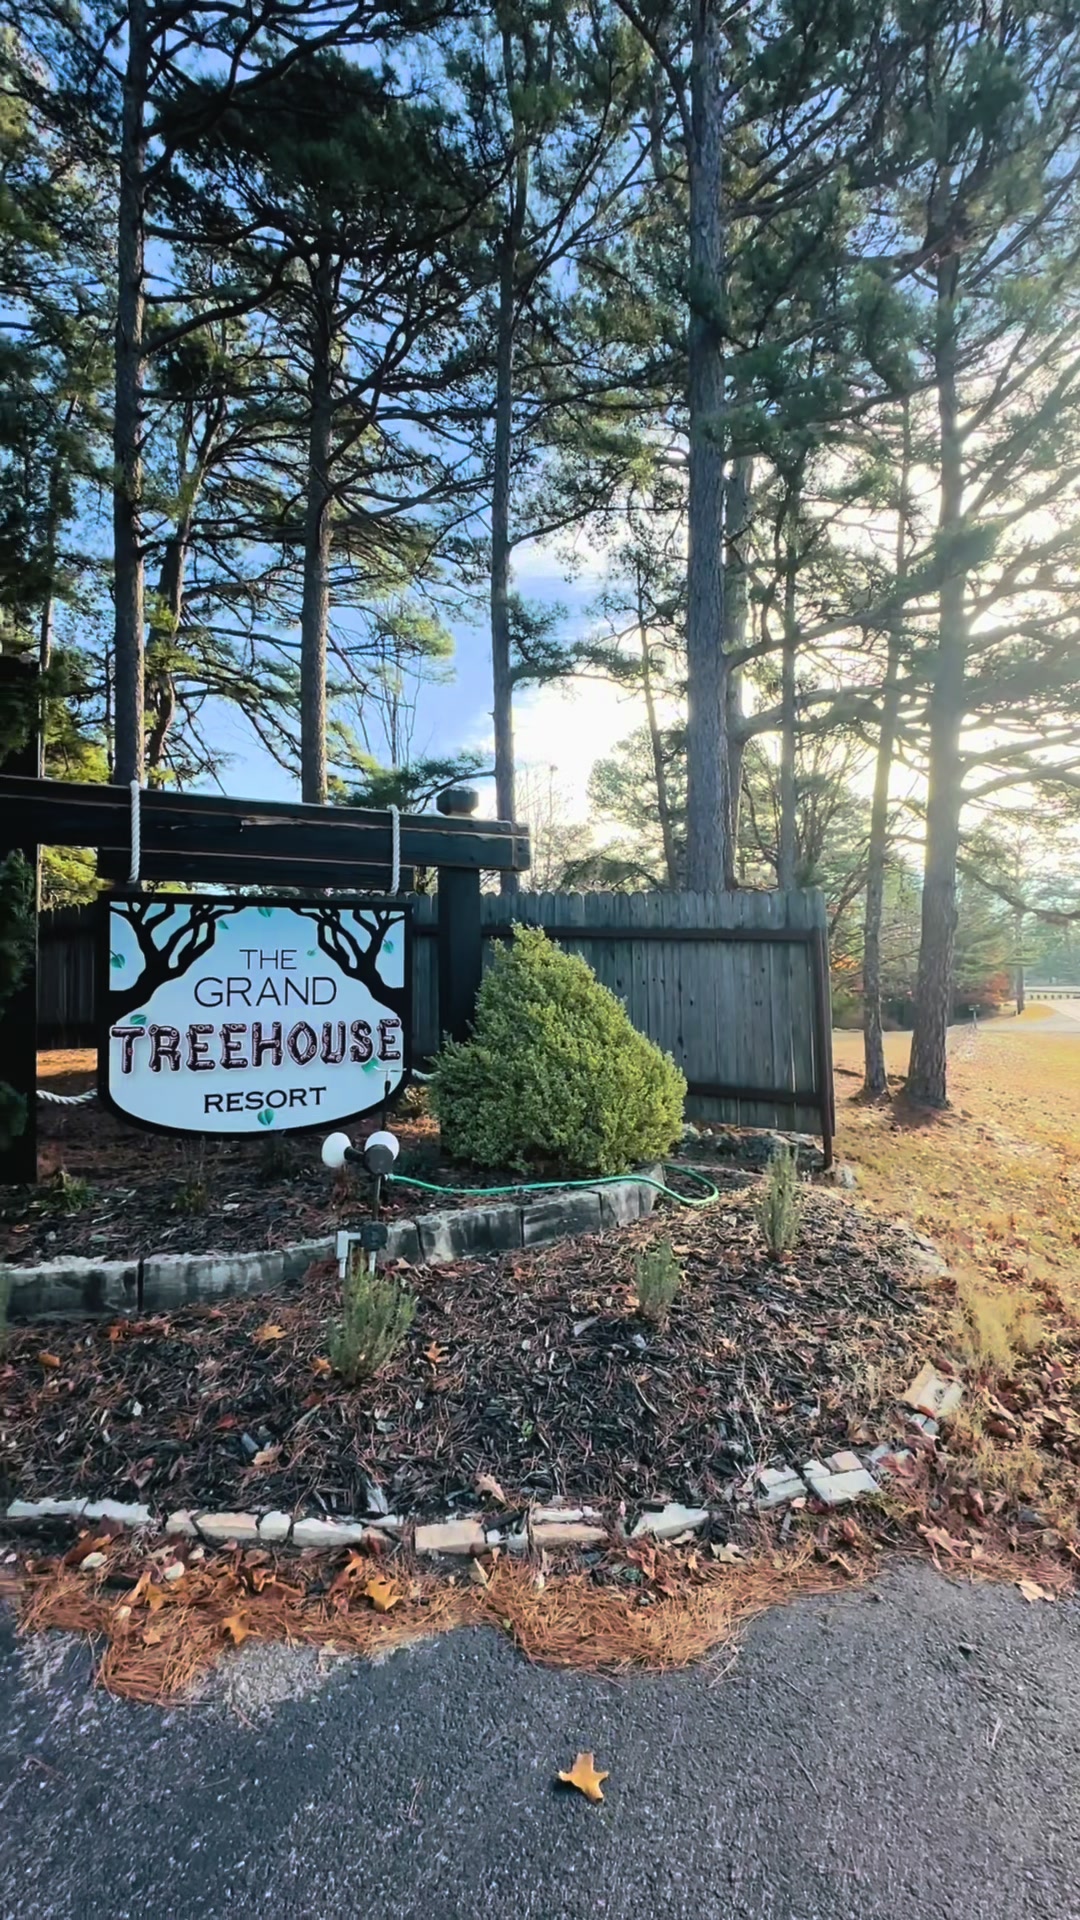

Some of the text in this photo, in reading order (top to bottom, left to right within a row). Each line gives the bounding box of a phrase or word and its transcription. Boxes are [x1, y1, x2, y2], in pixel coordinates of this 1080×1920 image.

[239, 949, 297, 970] THE
[194, 976, 337, 1008] GRAND
[109, 1017, 401, 1074] TREEHOUSE
[203, 1086, 327, 1114] RESORT
